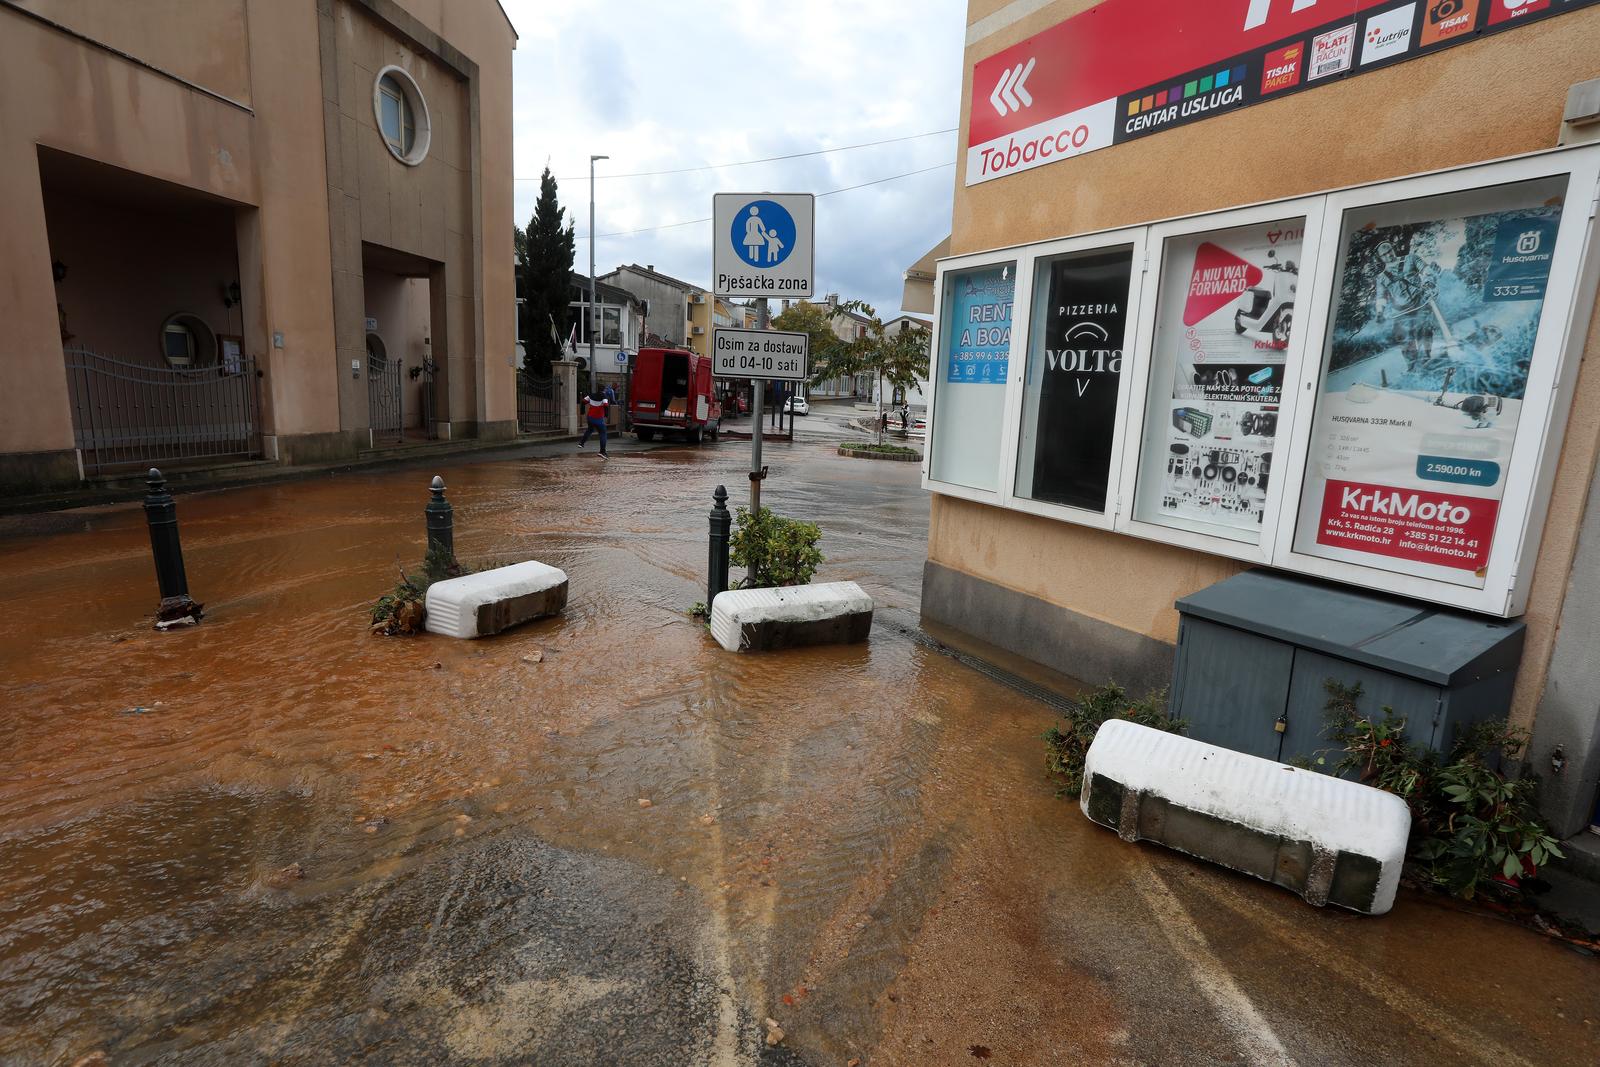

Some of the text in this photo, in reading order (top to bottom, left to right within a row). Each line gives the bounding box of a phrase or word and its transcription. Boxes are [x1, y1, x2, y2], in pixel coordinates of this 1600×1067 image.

[1511, 7, 1528, 18] bon
[1438, 23, 1468, 37] FOTO
[1439, 13, 1470, 30] TISAK
[1318, 35, 1348, 52] PLATI
[1377, 28, 1410, 44] Lutrija
[1266, 61, 1296, 79] TISAK
[1264, 73, 1295, 89] PAKET
[1125, 85, 1243, 134] CENTAR USLUGA
[980, 124, 1089, 176] Tobacco
[1502, 254, 1549, 263] Husqvarna
[1192, 264, 1248, 283] A NIU WAY
[719, 274, 808, 293] Pješačka zona
[1189, 278, 1247, 297] FORWARD
[1493, 285, 1520, 297] 333
[1059, 303, 1118, 316] PIZZERIA
[718, 336, 803, 355] Osim za dostavu
[960, 329, 972, 347] A
[722, 356, 799, 372] od 04-10 sati
[975, 351, 985, 360] 99
[987, 351, 992, 360] 6
[1204, 392, 1246, 401] ELEKTRIČNIH
[1246, 394, 1279, 403] SKUTERA
[1206, 384, 1222, 392] NAM
[1240, 385, 1274, 394] POTICAJE
[1274, 386, 1282, 394] Z
[1332, 415, 1369, 424] HUSQVARNA
[1370, 417, 1388, 425] 333R
[1389, 419, 1406, 427] Mark
[1427, 463, 1482, 477] 2.590,00 kn
[1341, 486, 1471, 525] KrkMoto
[1328, 518, 1344, 528] Krk,
[1383, 526, 1394, 535] 28
[1369, 515, 1387, 523] istom
[1387, 517, 1406, 526] broju
[1406, 521, 1434, 530] telefona
[1446, 526, 1466, 535] 1996.
[1325, 528, 1392, 545] www.krkmoto.hr
[1404, 530, 1478, 548] +385 51 22 14 41
[1399, 539, 1478, 559] info@krkmoto.hr
